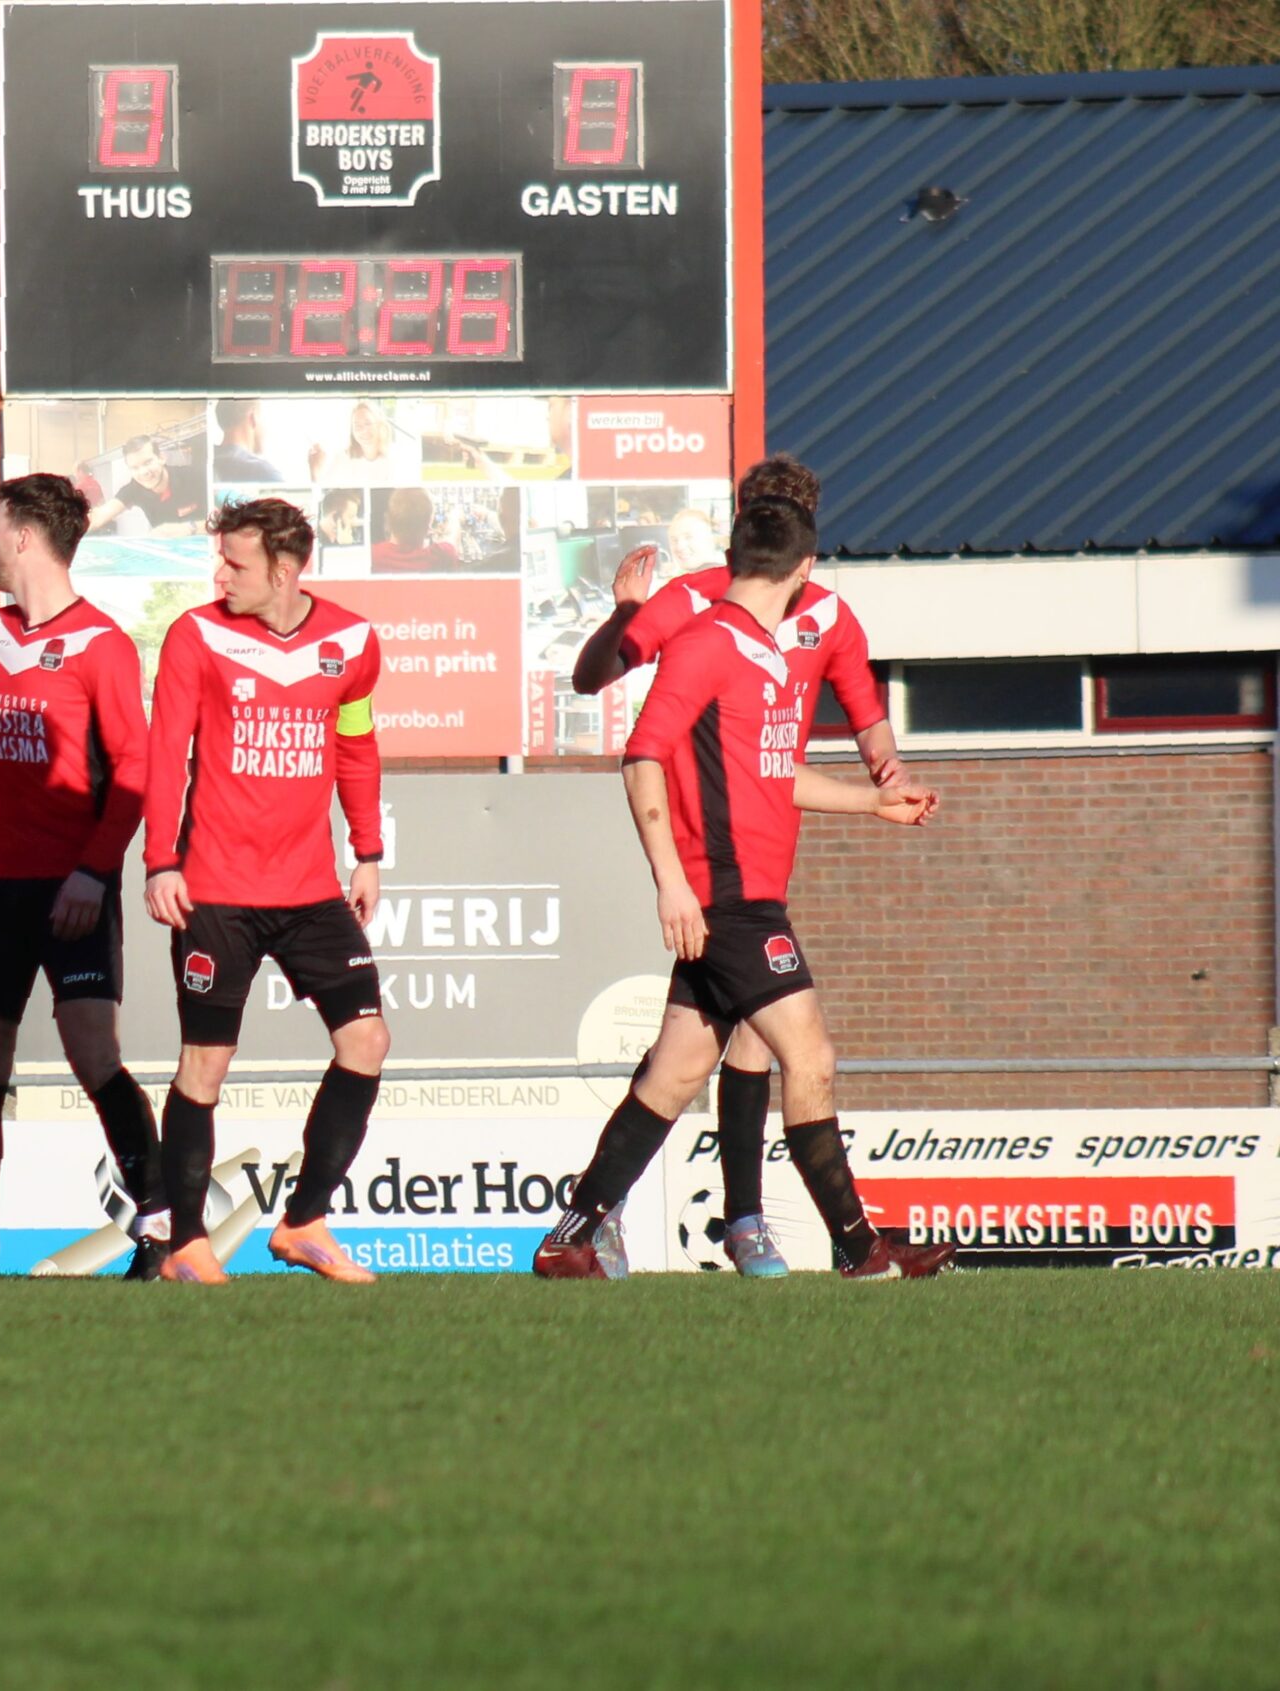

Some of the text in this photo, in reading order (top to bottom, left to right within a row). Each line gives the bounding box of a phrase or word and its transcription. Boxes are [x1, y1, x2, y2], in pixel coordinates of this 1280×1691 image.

[305, 47, 426, 105] VOETBALVERENIGING
[306, 124, 426, 147] BROEKSTER
[338, 149, 393, 171] BOYS
[343, 175, 390, 187] Opgericht
[77, 187, 193, 219] THUIS
[521, 184, 678, 217] GASTEN
[591, 414, 661, 428] werken bij
[615, 426, 705, 460] probo
[454, 618, 477, 641] in
[385, 651, 497, 678] van print
[232, 720, 325, 749] DIJKSTRA
[231, 746, 324, 778] DRAISMA
[759, 751, 796, 779] DRAIS
[362, 897, 560, 947] WERIJ
[267, 973, 476, 1010] DKUM
[377, 1085, 560, 1107] RD-NEDERLAND
[868, 1128, 1053, 1162] Johannes
[1075, 1133, 1261, 1167] sponsors
[367, 1157, 463, 1215] der
[908, 1203, 1215, 1245] BROEKSTER BOYS
[337, 1233, 514, 1268] nstallaties
